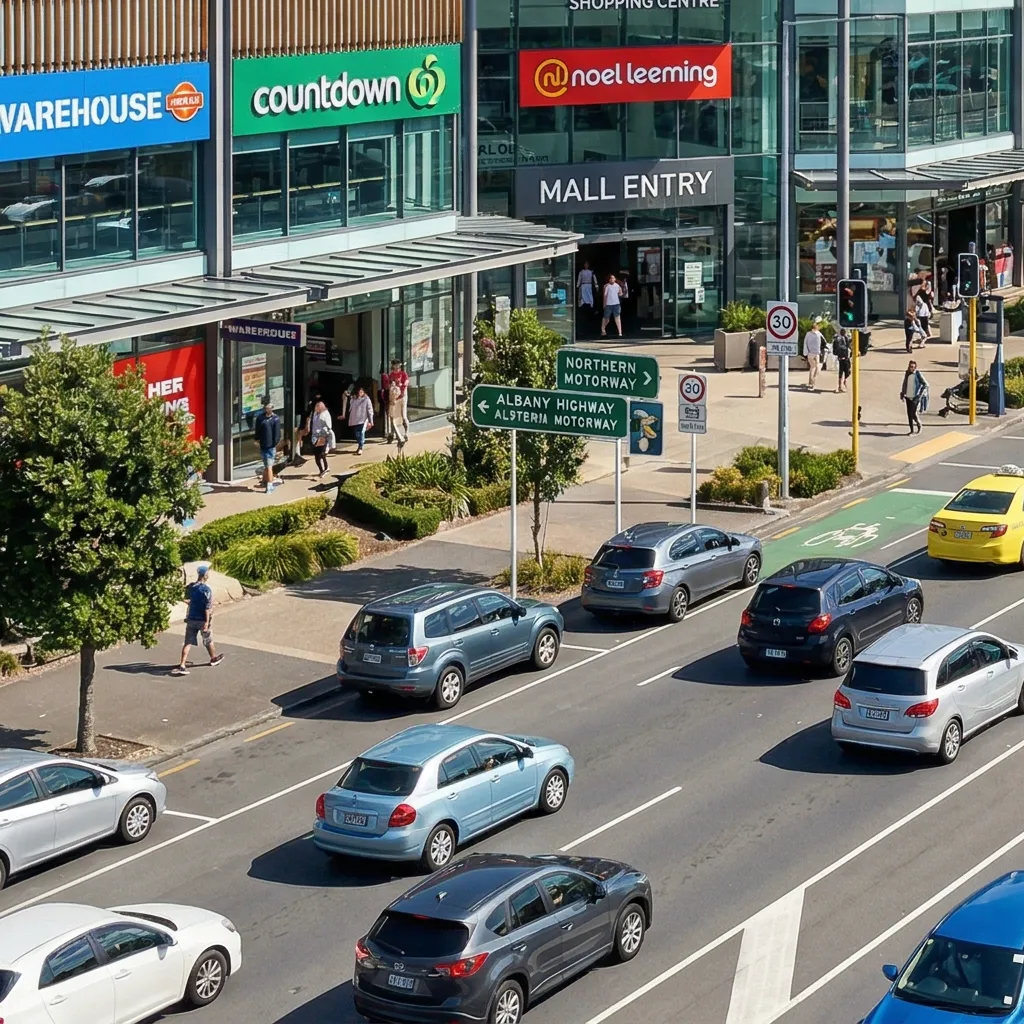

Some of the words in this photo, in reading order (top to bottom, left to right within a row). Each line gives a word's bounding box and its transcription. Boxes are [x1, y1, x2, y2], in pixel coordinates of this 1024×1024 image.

[571, 62, 623, 87] noel
[627, 59, 718, 88] leeming
[253, 71, 402, 115] countdown
[540, 176, 616, 204] MALL
[623, 170, 713, 199] ENTRY
[772, 315, 791, 329] 30
[566, 356, 636, 374] NORTHERN
[564, 372, 637, 391] MOTORWAY
[685, 382, 700, 394] 30
[496, 393, 551, 409] ALBANY
[556, 398, 615, 415] HIGHWAY
